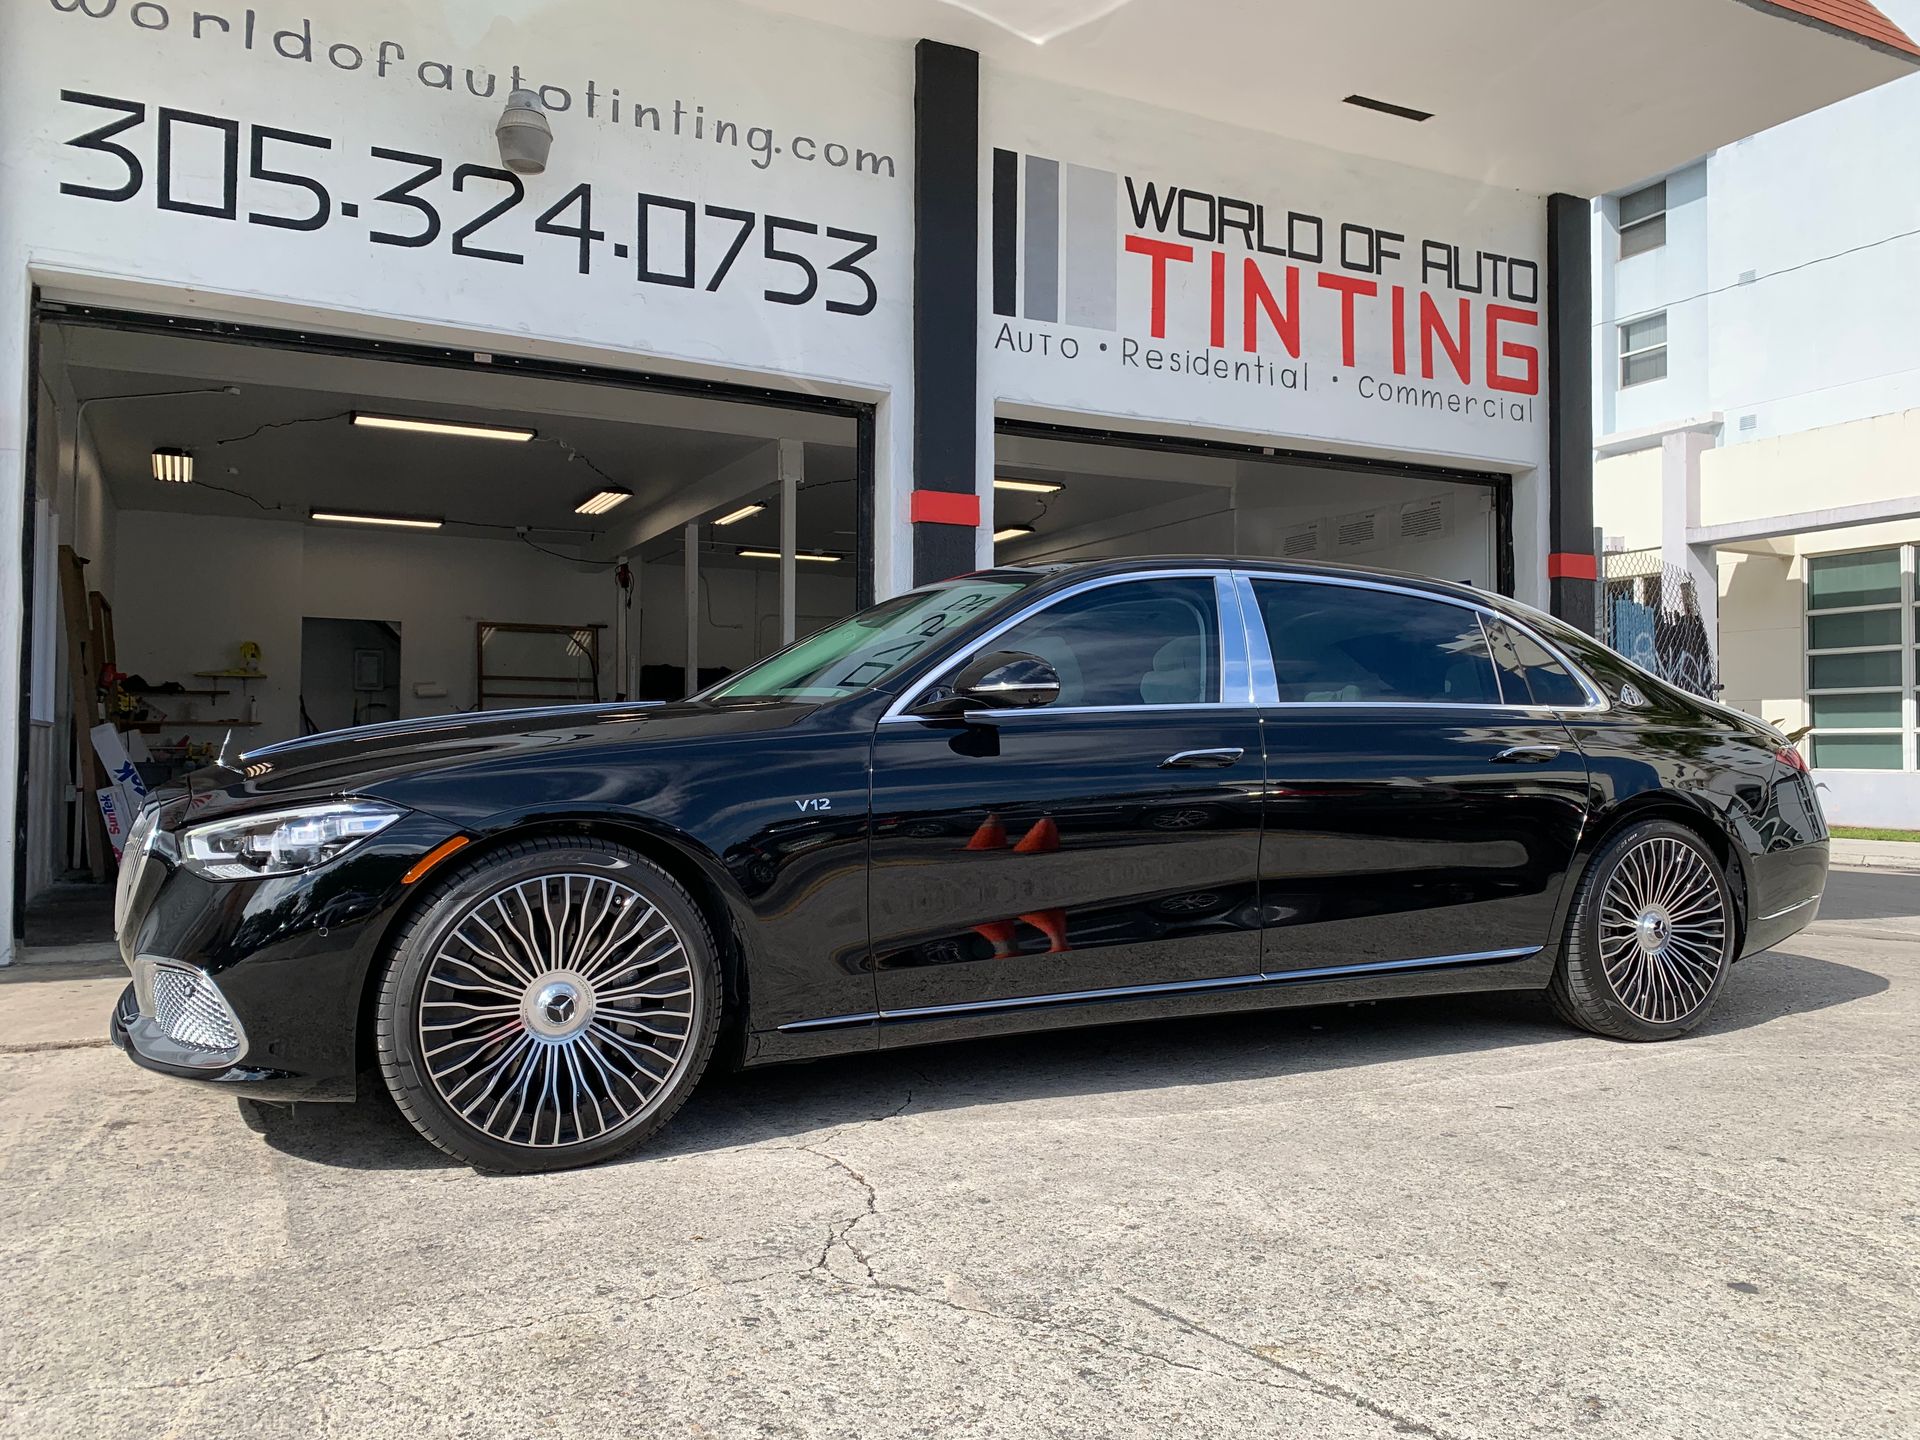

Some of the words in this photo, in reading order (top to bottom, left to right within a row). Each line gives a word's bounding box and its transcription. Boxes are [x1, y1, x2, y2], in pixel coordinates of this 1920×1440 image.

[1124, 176, 1323, 264] WORLD
[1341, 222, 1405, 275] OF
[1422, 239, 1538, 304] AUTO
[1125, 234, 1539, 396] TINTING
[1122, 337, 1308, 391] Residential
[1358, 375, 1533, 423] Commercial
[100, 794, 120, 835] SunTek
[795, 798, 831, 811] V12
